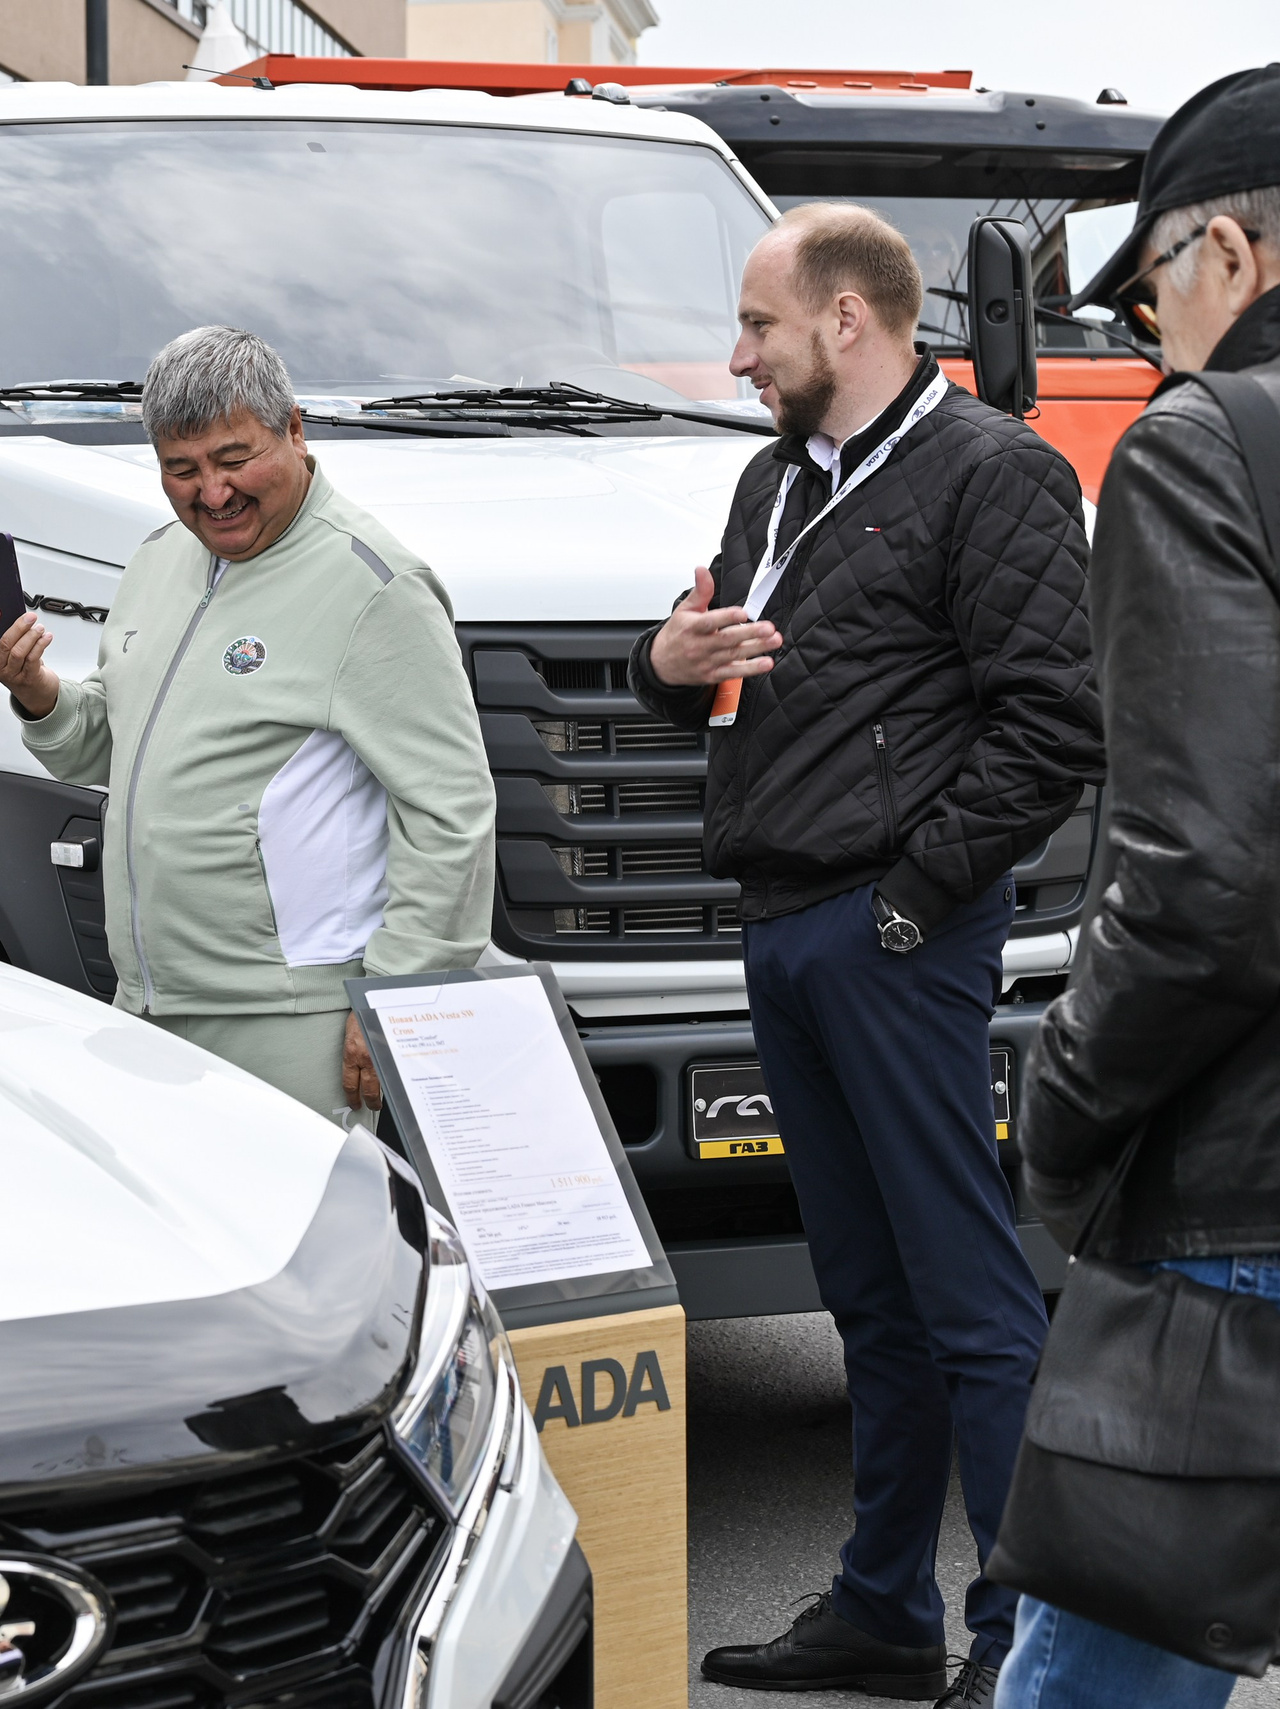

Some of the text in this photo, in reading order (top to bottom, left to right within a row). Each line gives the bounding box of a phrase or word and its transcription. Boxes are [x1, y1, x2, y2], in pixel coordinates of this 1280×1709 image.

[923, 389, 938, 405] LADA
[414, 1013, 439, 1022] LADA
[439, 1011, 460, 1020] Vesta
[461, 1009, 474, 1017] SW
[729, 1141, 768, 1154] ГАЗ
[533, 1350, 671, 1433] ADA
